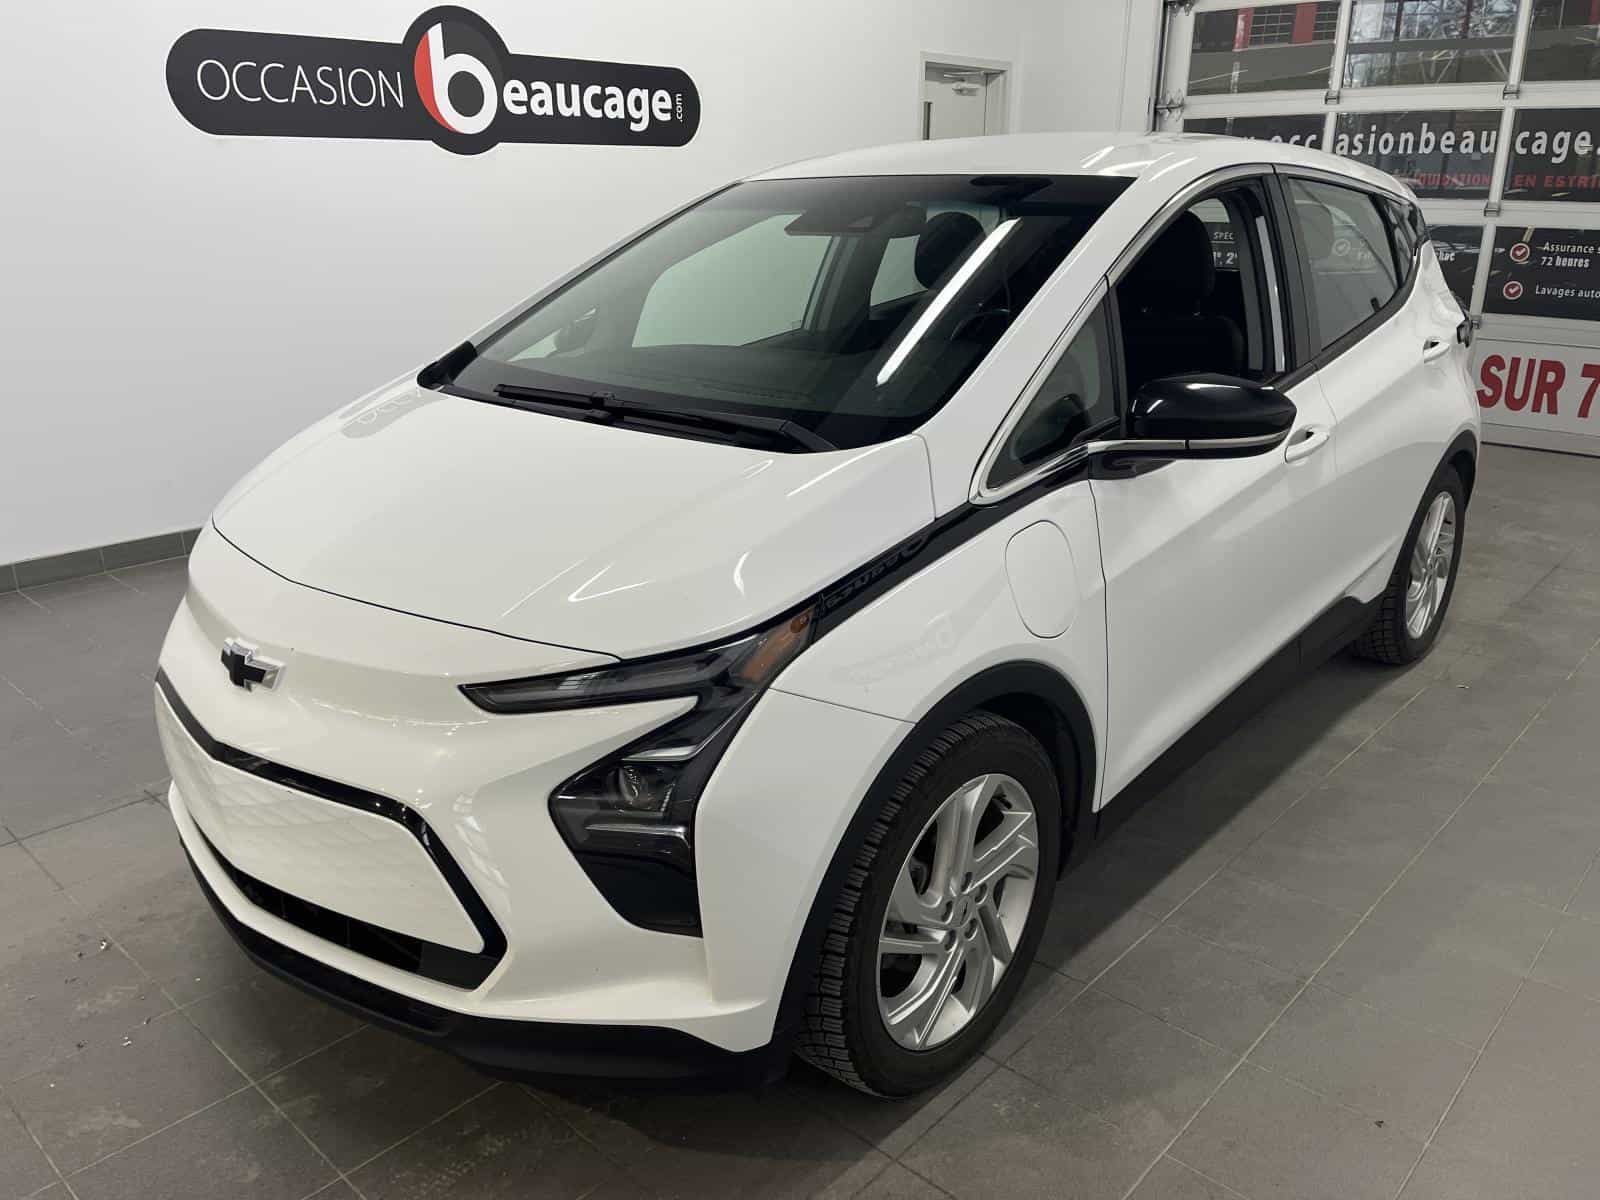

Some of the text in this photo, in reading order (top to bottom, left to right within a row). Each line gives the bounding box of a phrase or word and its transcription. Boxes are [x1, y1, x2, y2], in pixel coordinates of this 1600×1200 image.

[196, 58, 404, 109] OCCASION
[675, 93, 683, 123] .com
[1514, 173, 1537, 188] EN
[1543, 241, 1595, 254] Assurance
[1541, 255, 1590, 268] 72 heures
[1535, 284, 1576, 298] Lavages
[1476, 354, 1600, 419] SUR 7
